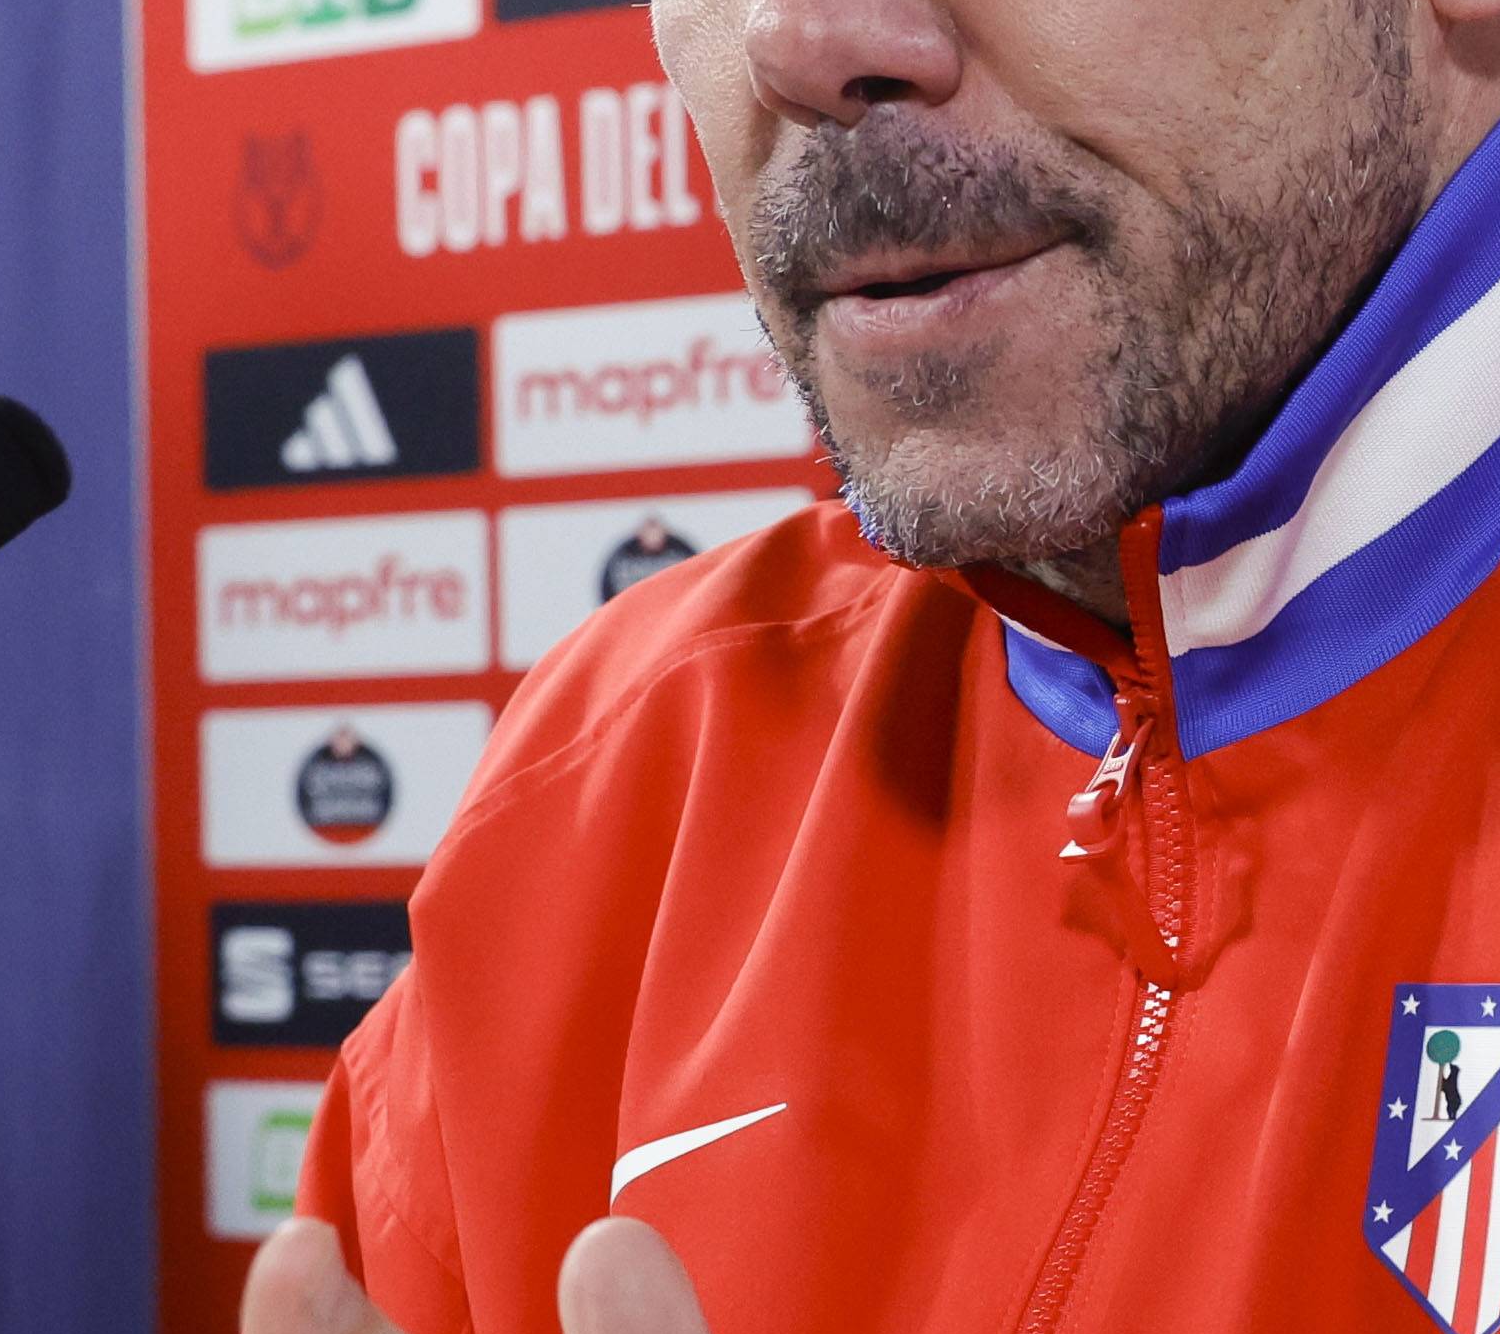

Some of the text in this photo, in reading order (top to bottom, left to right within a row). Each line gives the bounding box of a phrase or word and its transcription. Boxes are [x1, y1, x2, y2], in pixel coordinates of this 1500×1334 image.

[396, 83, 698, 256] COPA DEL
[516, 339, 788, 425] mapfre
[219, 555, 466, 637] mapfre
